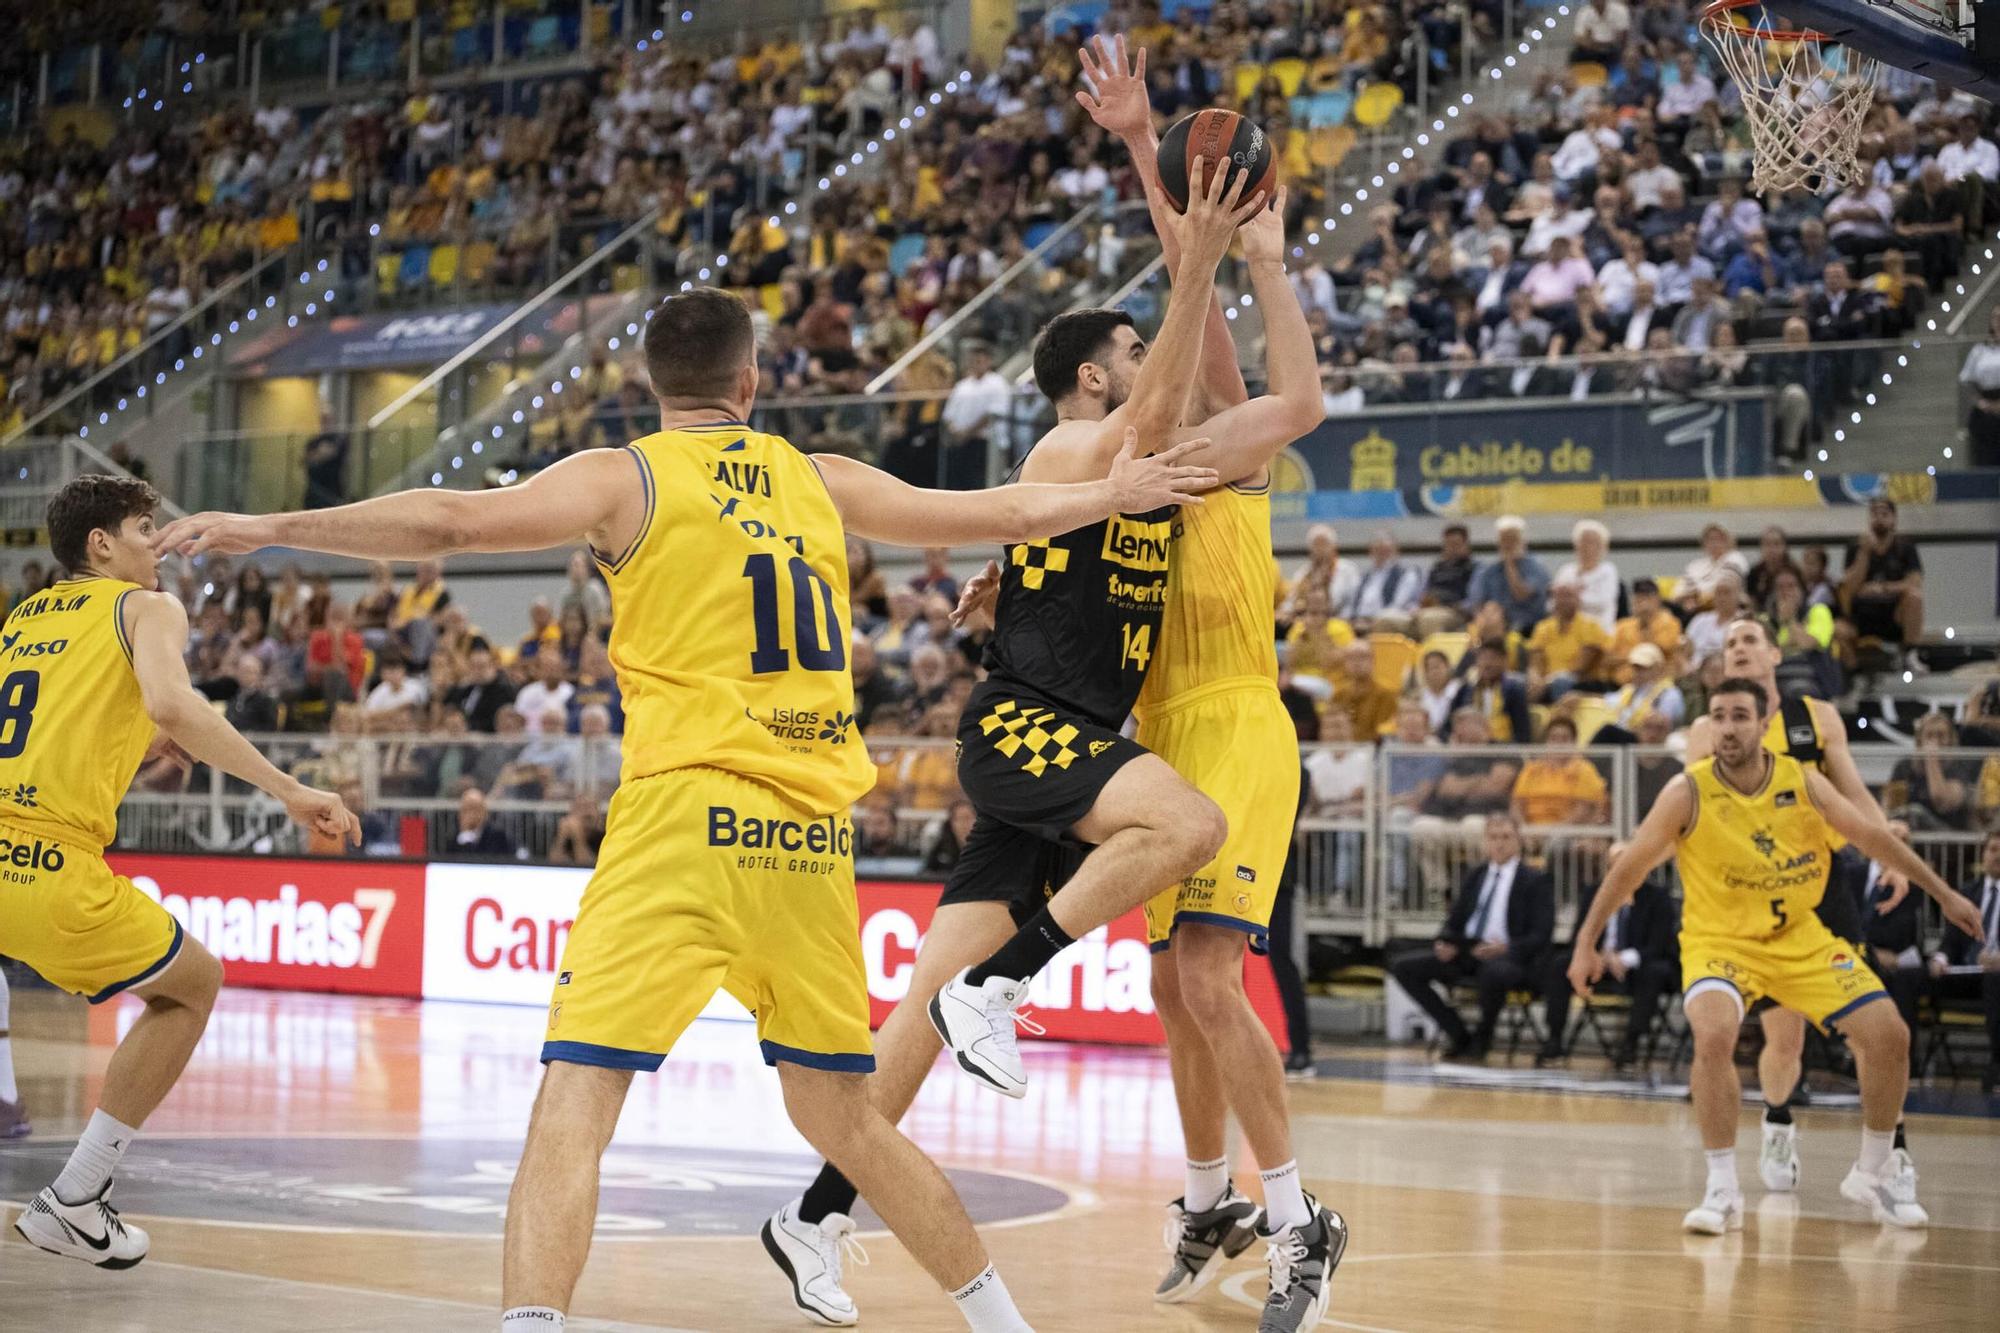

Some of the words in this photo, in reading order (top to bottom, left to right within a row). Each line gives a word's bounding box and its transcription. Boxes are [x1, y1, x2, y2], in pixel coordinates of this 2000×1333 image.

[1419, 442, 1544, 478] Cabildo
[1550, 438, 1593, 474] de
[742, 553, 846, 674] 10
[1121, 622, 1151, 672] 14
[773, 708, 820, 725] Islas
[708, 806, 849, 857] Barceló
[0, 839, 64, 872] celó
[737, 855, 779, 870] HOTEL
[788, 859, 835, 875] GROUP
[3, 870, 36, 886] ROUP
[1770, 898, 1788, 931] 5
